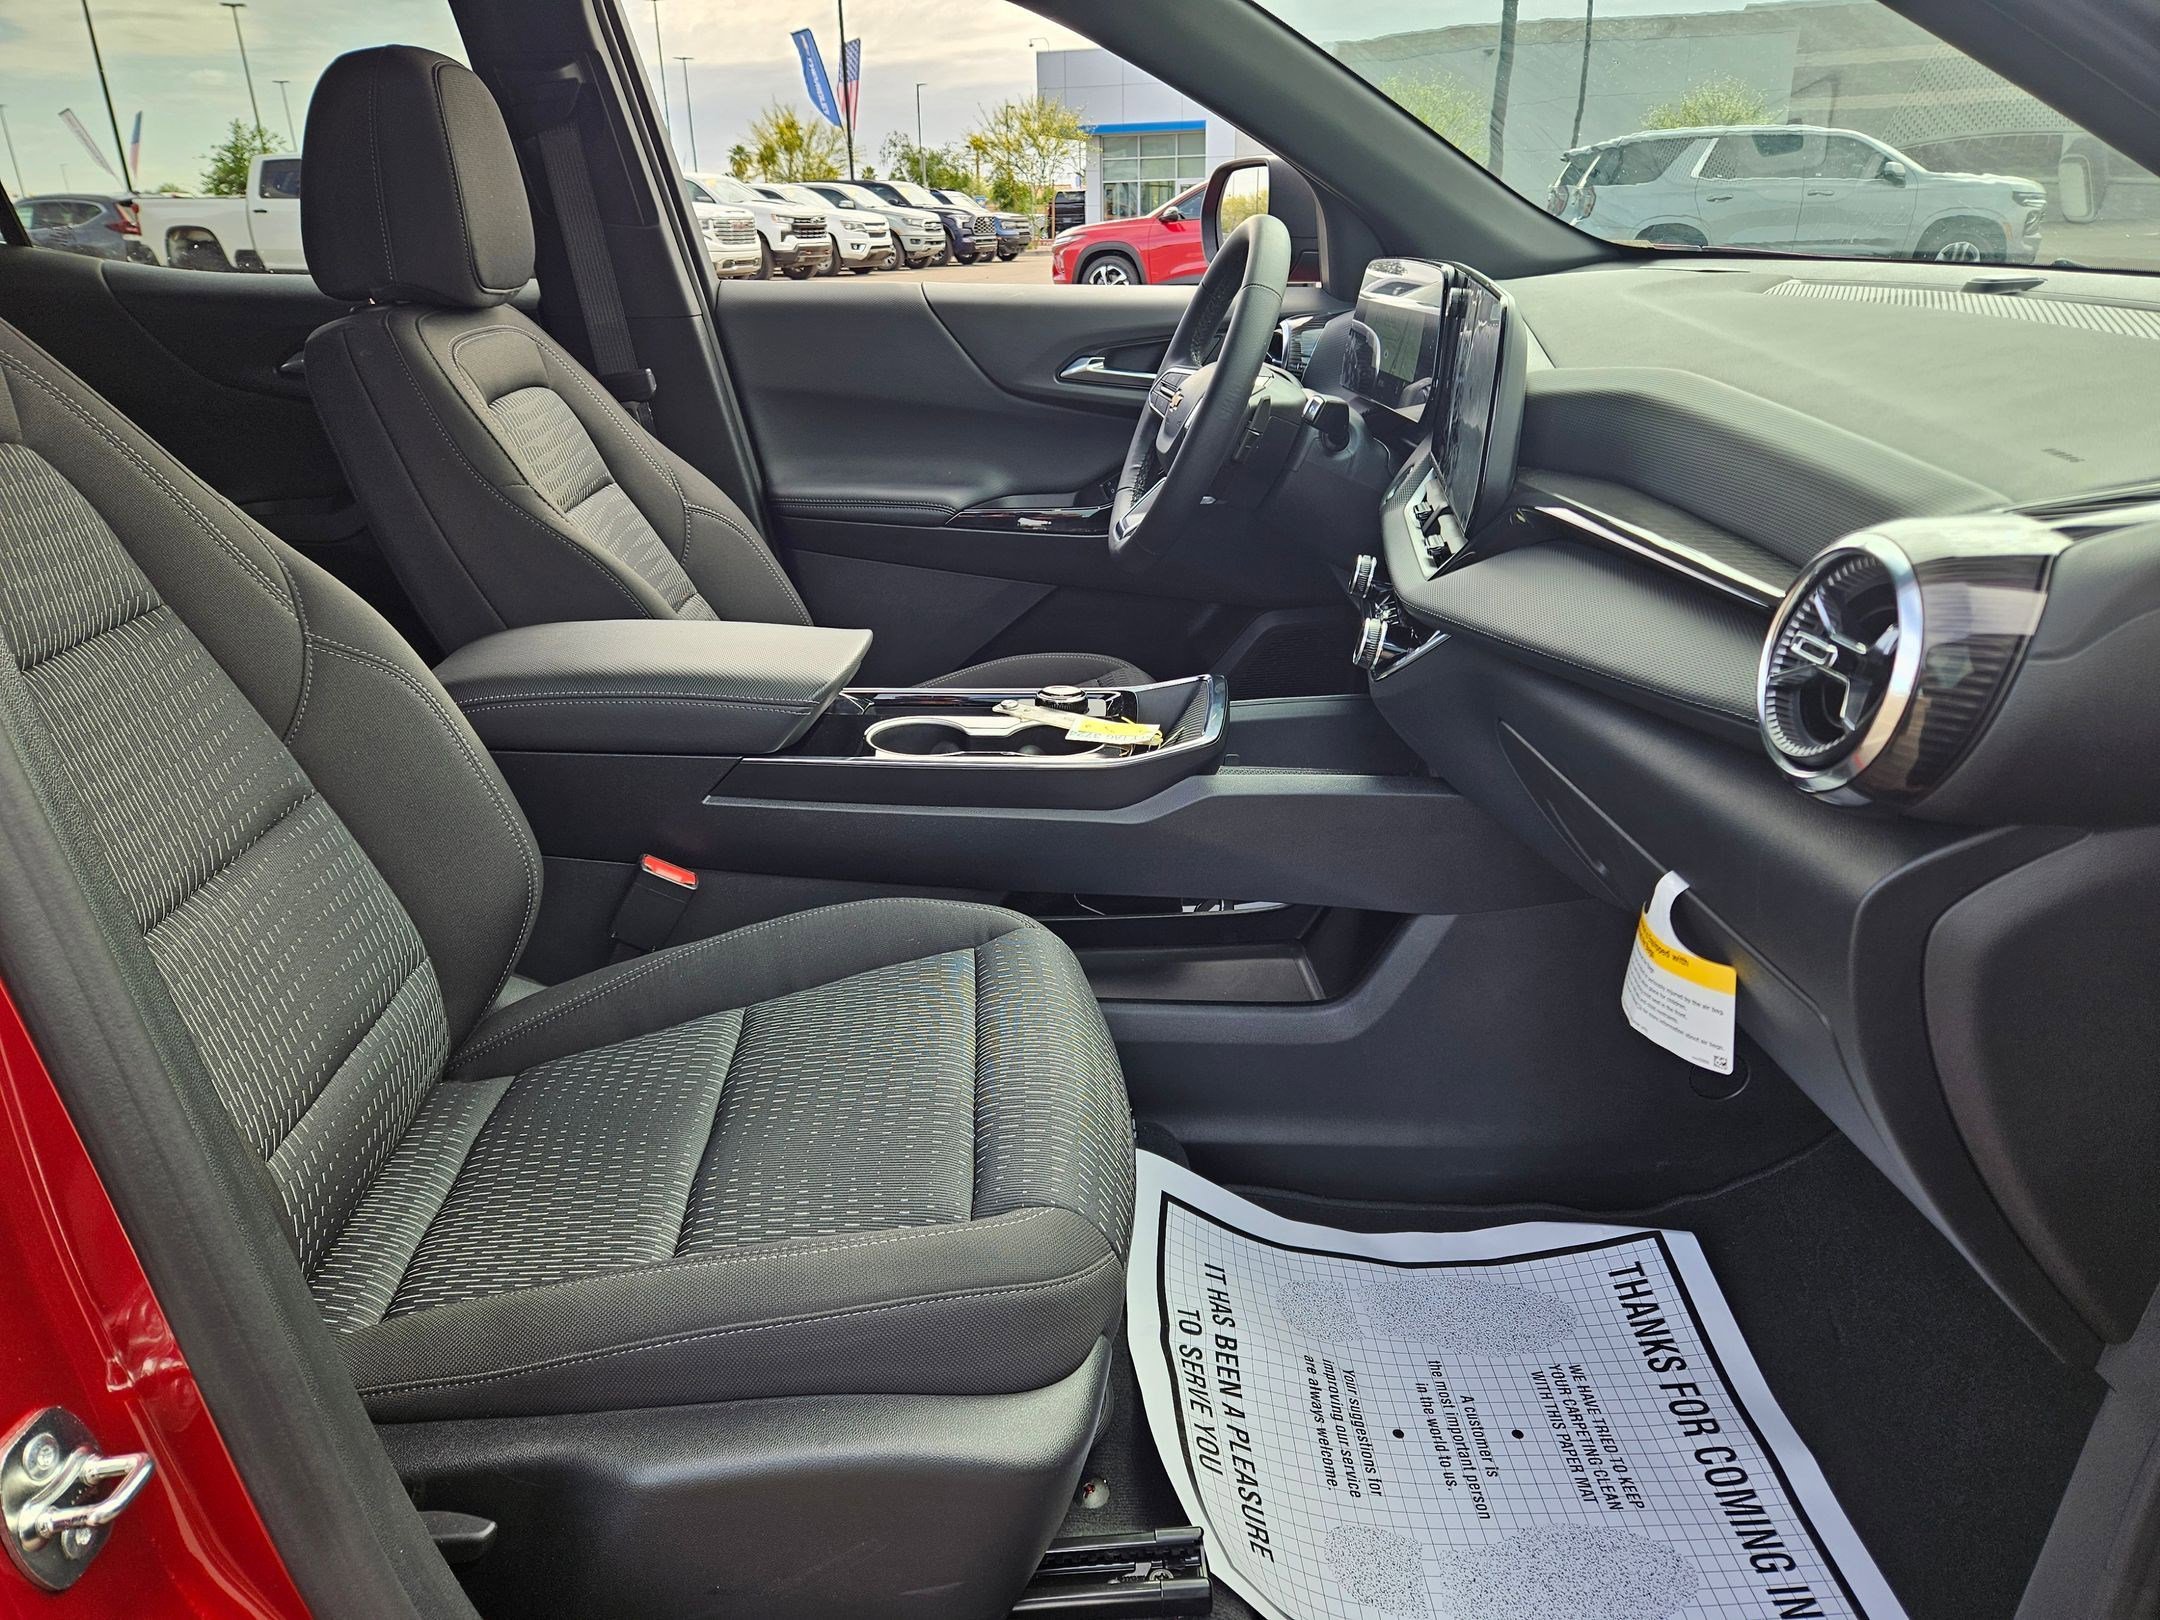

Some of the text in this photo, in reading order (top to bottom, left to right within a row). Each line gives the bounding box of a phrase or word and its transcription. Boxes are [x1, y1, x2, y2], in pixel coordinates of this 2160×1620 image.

[1177, 1309, 1223, 1476] TO SERVE YOU
[1204, 1263, 1275, 1563] IT HAS BEEN A PLEASURE
[1304, 1354, 1338, 1491] are always welcome.
[1323, 1358, 1361, 1498] improving our service
[1343, 1370, 1382, 1496] Your suggestions for
[1416, 1383, 1458, 1491] in the world to us.
[1428, 1360, 1491, 1520] the most important person
[1460, 1395, 1499, 1478] A customer is
[1531, 1370, 1599, 1504] WITH THIS PAPER MAT
[1549, 1363, 1624, 1510] YOUR CARPETING CLEAN
[1568, 1364, 1645, 1510] WE HAVE TRIED TO KEEP
[1608, 1261, 1825, 1620] THANKS FOR COMING IN
